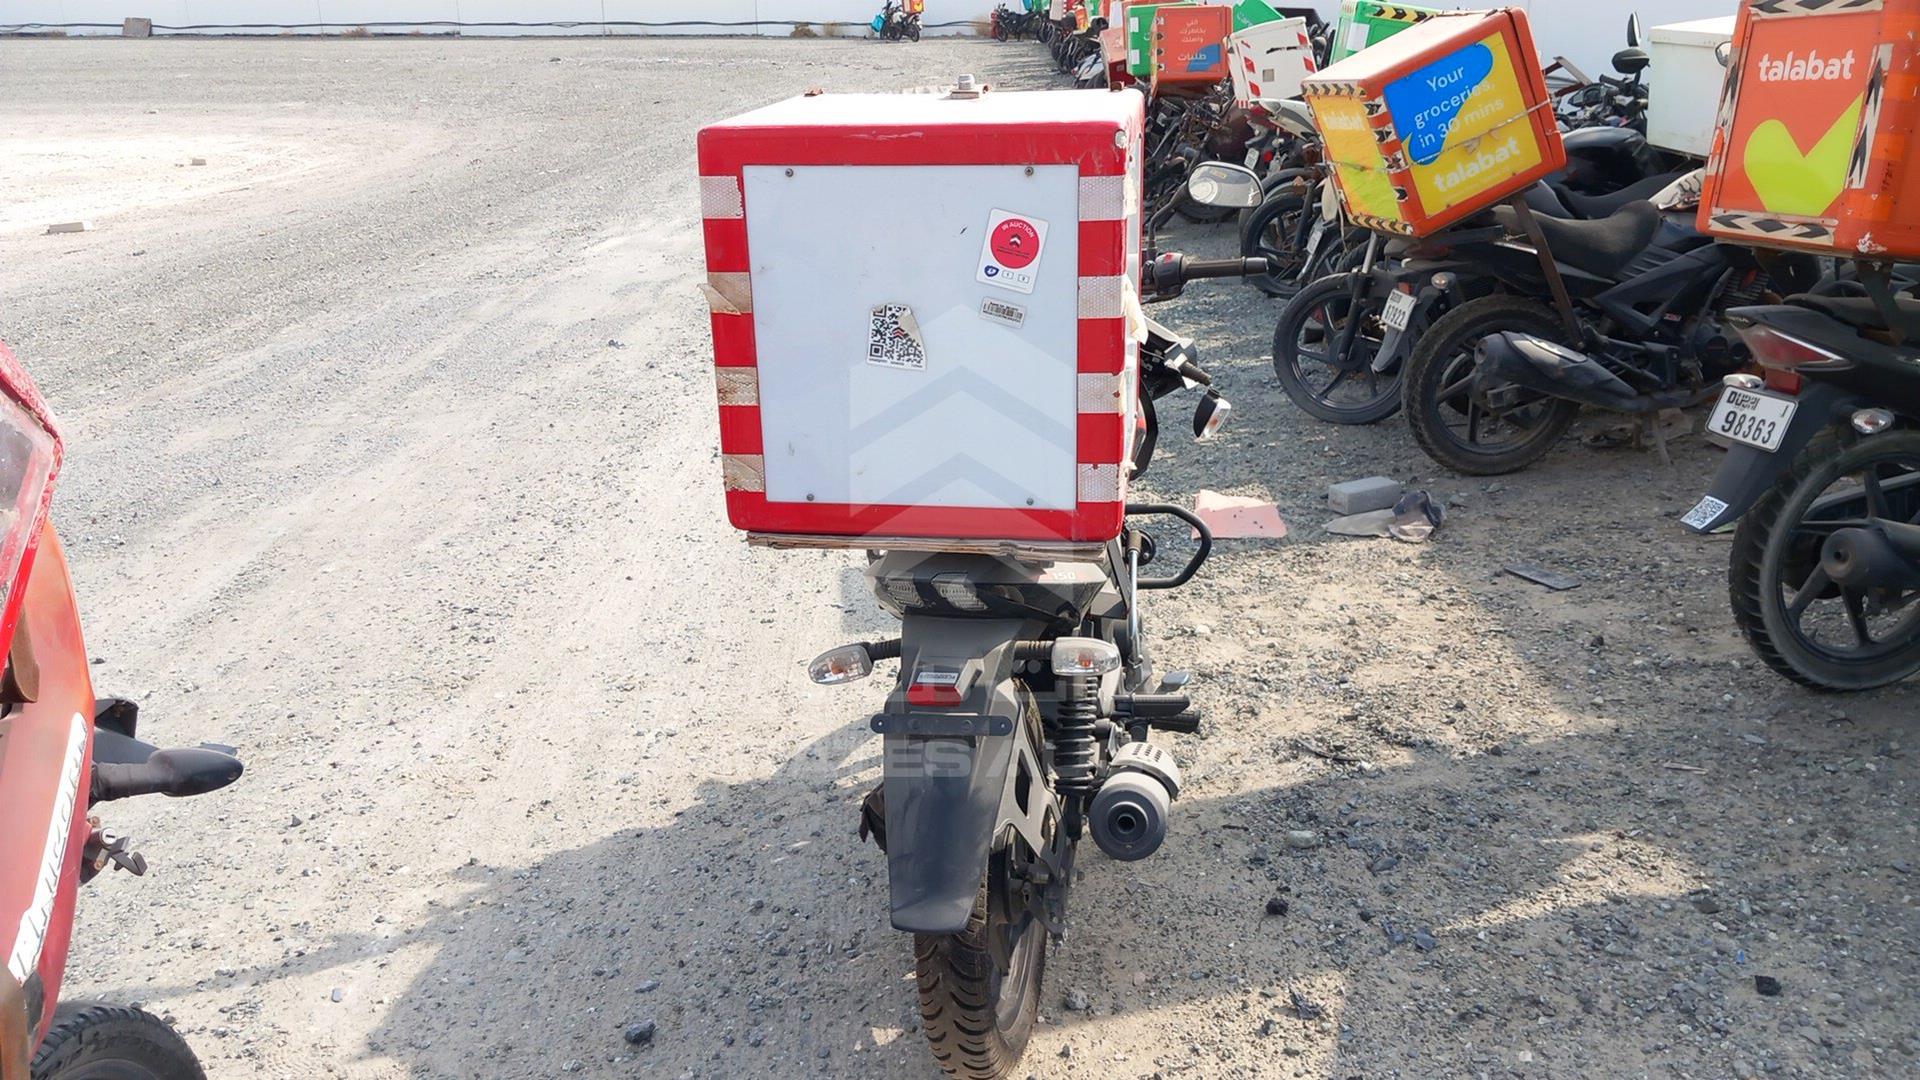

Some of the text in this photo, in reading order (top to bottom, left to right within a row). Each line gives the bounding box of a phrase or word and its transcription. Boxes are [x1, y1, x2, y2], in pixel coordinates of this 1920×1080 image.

[1426, 66, 1464, 92] Your
[1758, 49, 1855, 82] talabat
[1418, 98, 1505, 148] in 30 mins
[1434, 136, 1521, 193] talabat
[1009, 221, 1035, 238] AUCTION
[1721, 410, 1776, 444] 98363
